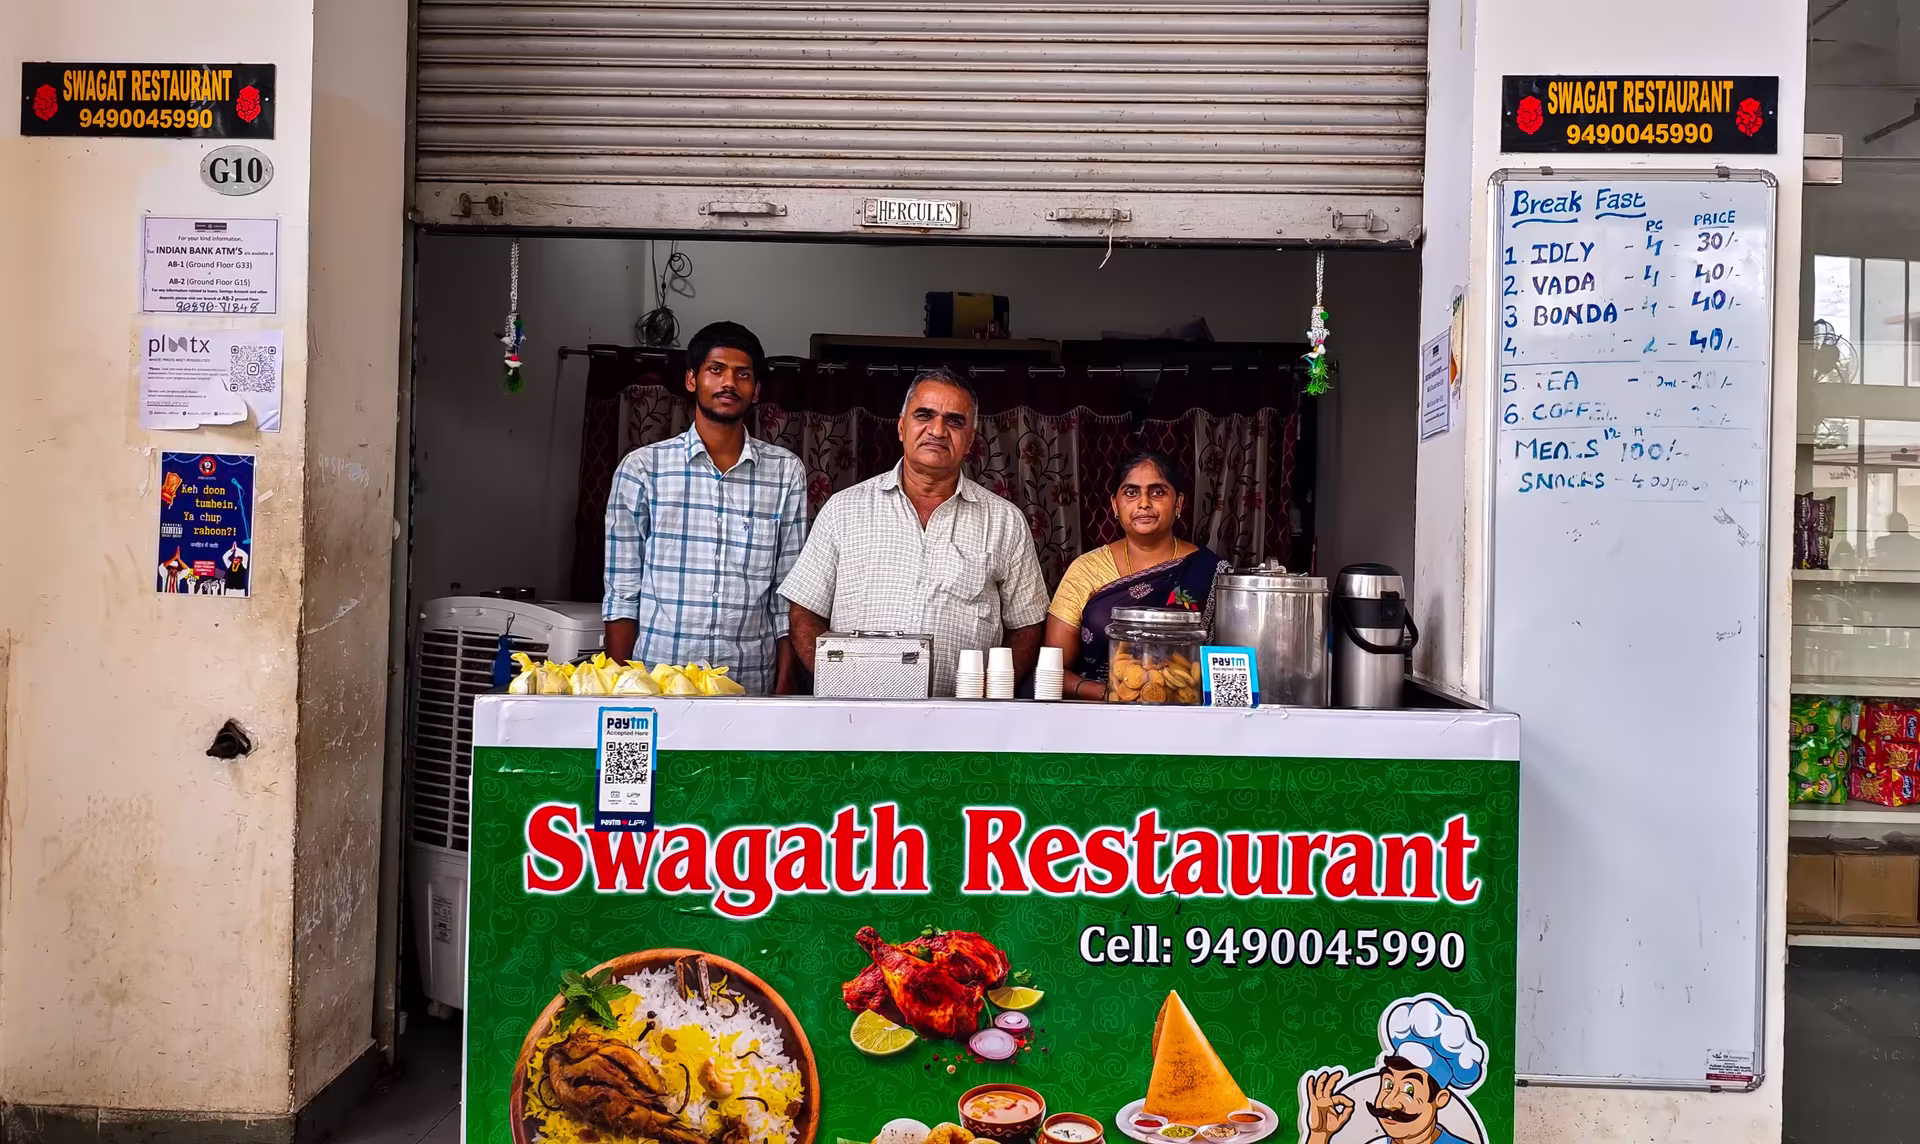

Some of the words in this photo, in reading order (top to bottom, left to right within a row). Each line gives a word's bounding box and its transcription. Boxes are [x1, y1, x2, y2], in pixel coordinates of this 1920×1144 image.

[63, 69, 126, 101] SWAGAT
[131, 69, 233, 101] RESTAURANT
[1548, 80, 1618, 114] SWAGAT
[1623, 80, 1734, 113] RESTAURANT
[79, 108, 213, 128] 9490045990
[1566, 123, 1713, 145] 9490045990
[209, 157, 263, 183] G10
[879, 200, 953, 223] HERCULES
[1510, 190, 1583, 217] Break
[1595, 188, 1646, 211] Fast
[1694, 210, 1736, 226] PRICE
[156, 246, 187, 255] INDIAN
[190, 247, 214, 255] BANK
[215, 247, 243, 255] ATM'S
[1531, 241, 1595, 264] IDLY
[186, 261, 214, 269] (Ground
[187, 278, 214, 286] (Ground
[1532, 272, 1595, 295] VADA
[1533, 301, 1617, 326] BONDA
[1515, 438, 1599, 460] MEAS
[181, 484, 198, 494] Keh
[203, 486, 226, 495] doon
[195, 499, 238, 510] tumhein,
[184, 511, 194, 521] Ya
[200, 512, 222, 524] chup
[193, 526, 237, 536] rahoon?!
[525, 803, 931, 918] Swagath
[962, 806, 1481, 903] Restaurant
[1079, 924, 1174, 967] Cell:
[1184, 926, 1466, 970] 9490045990
